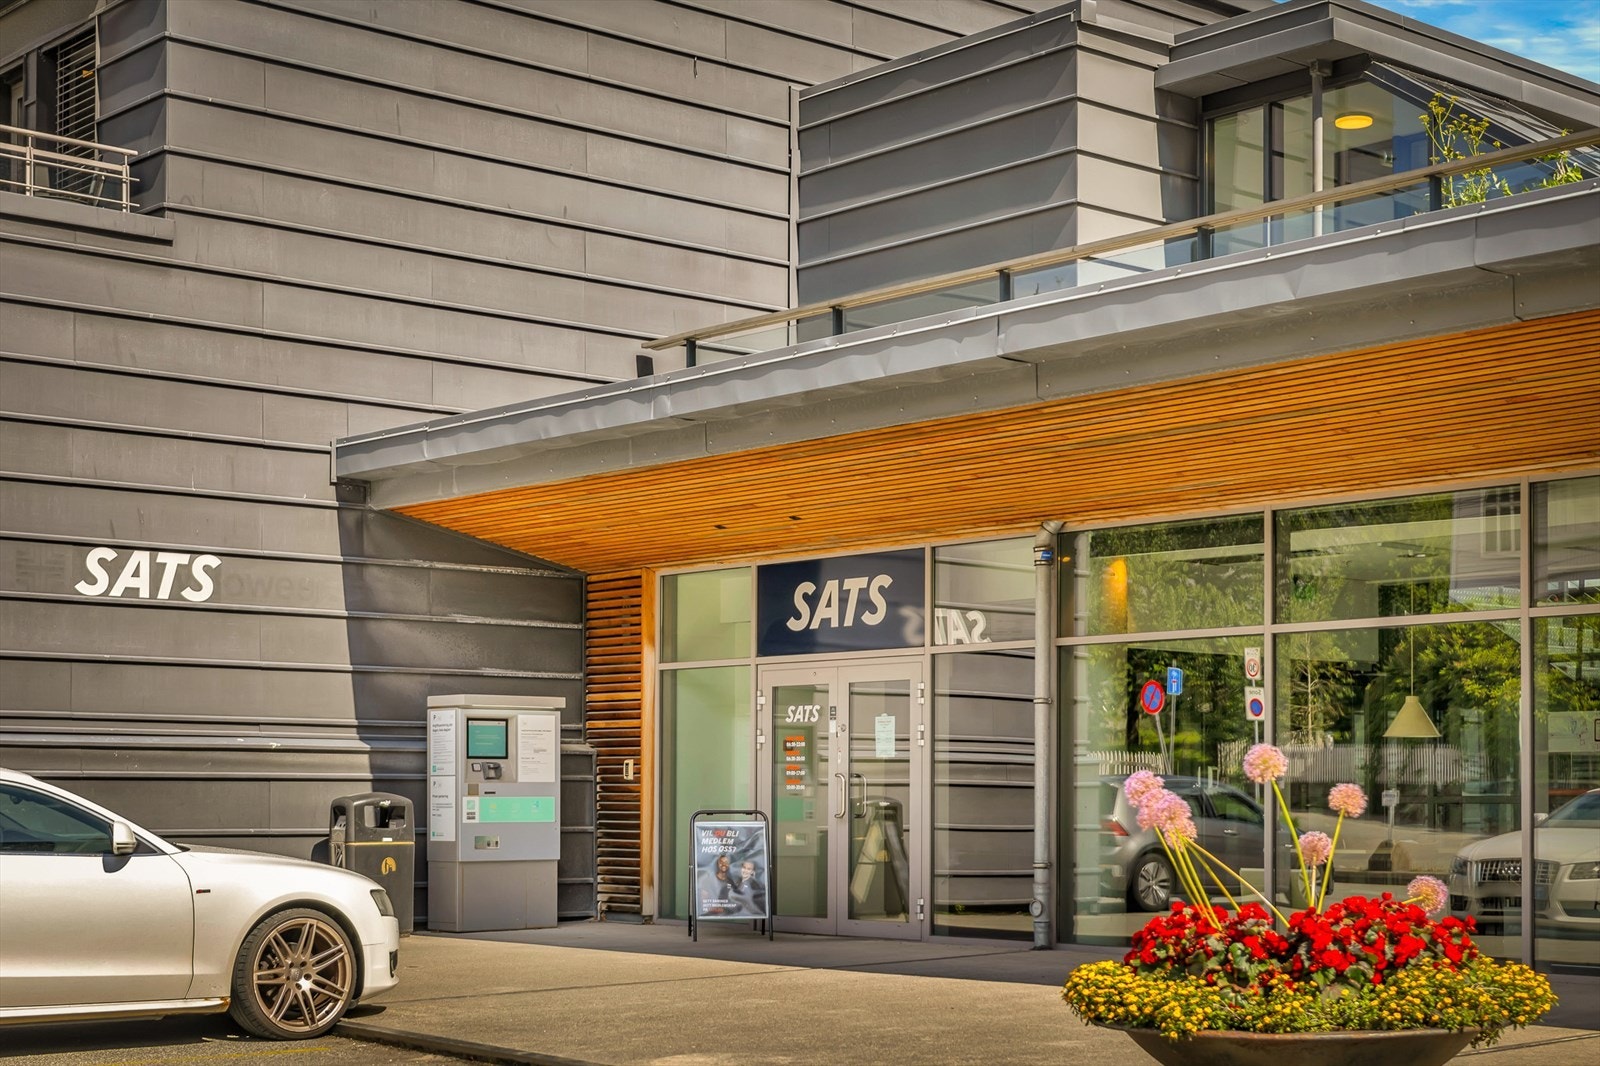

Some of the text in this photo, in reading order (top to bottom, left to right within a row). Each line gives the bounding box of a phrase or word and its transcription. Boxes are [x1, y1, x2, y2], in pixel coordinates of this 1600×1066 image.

[75, 547, 222, 602] SATS
[786, 574, 893, 632] SATS
[785, 705, 820, 723] SATS
[701, 837, 735, 845] MEDLEM
[718, 845, 737, 853] OSS?
